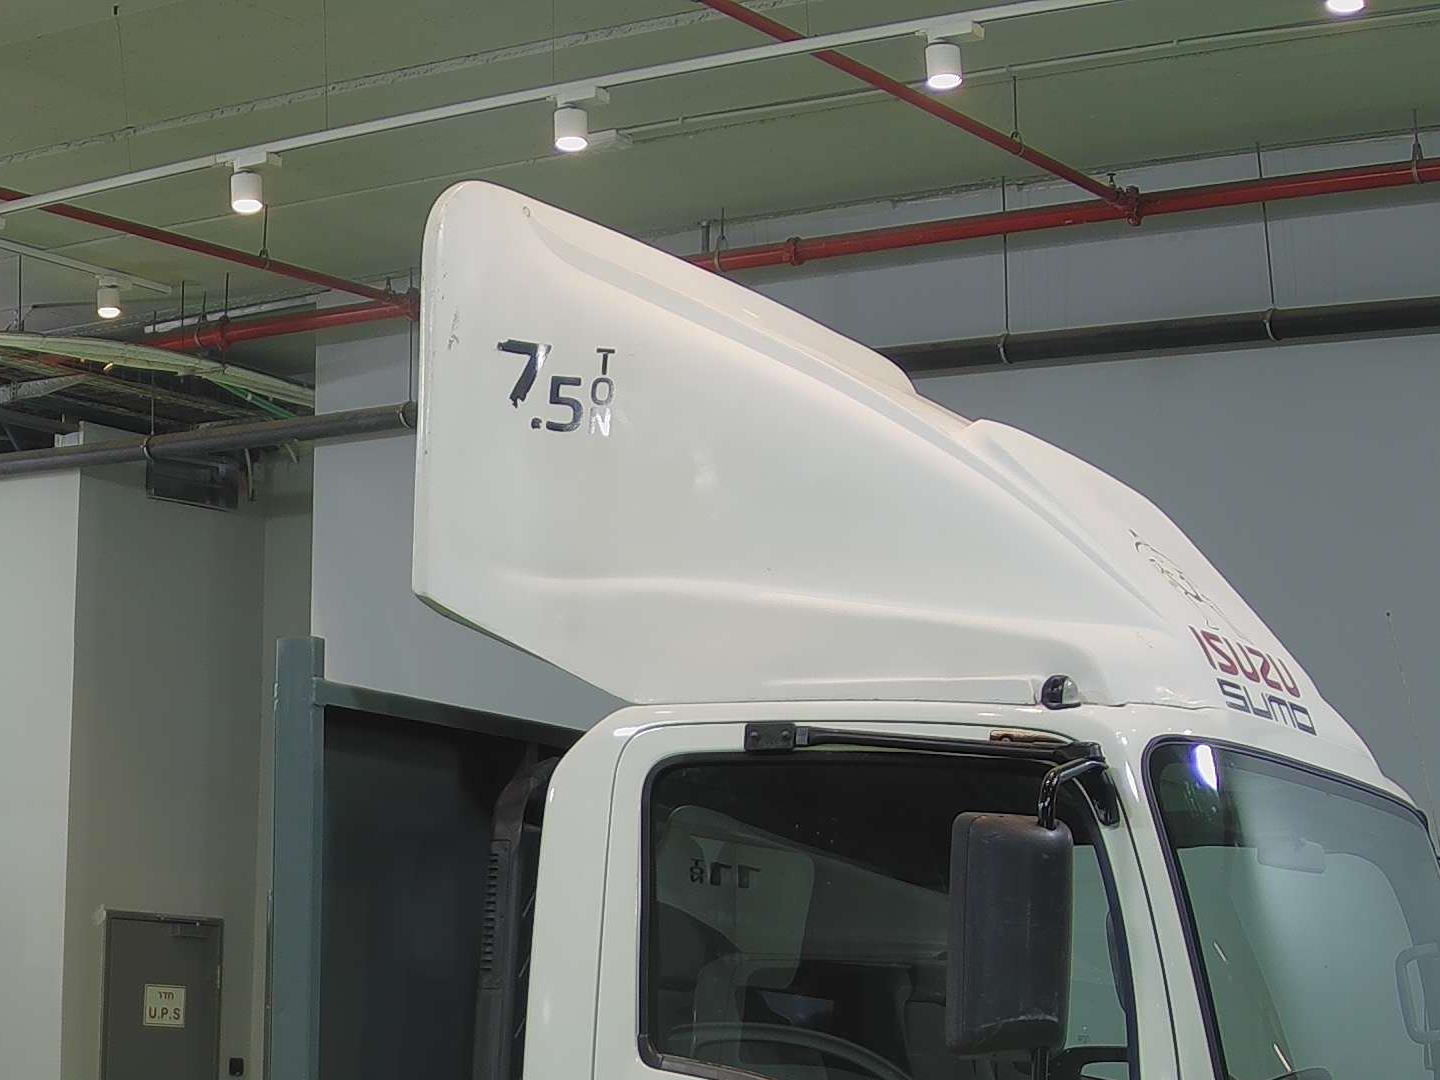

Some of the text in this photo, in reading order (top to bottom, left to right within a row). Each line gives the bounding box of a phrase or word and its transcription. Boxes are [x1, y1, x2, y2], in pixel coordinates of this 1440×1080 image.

[497, 339, 616, 438] 7.5 TON
[1188, 624, 1301, 698] ISUZU
[1216, 677, 1318, 737] SUMO
[148, 1007, 181, 1020] U.P.S
